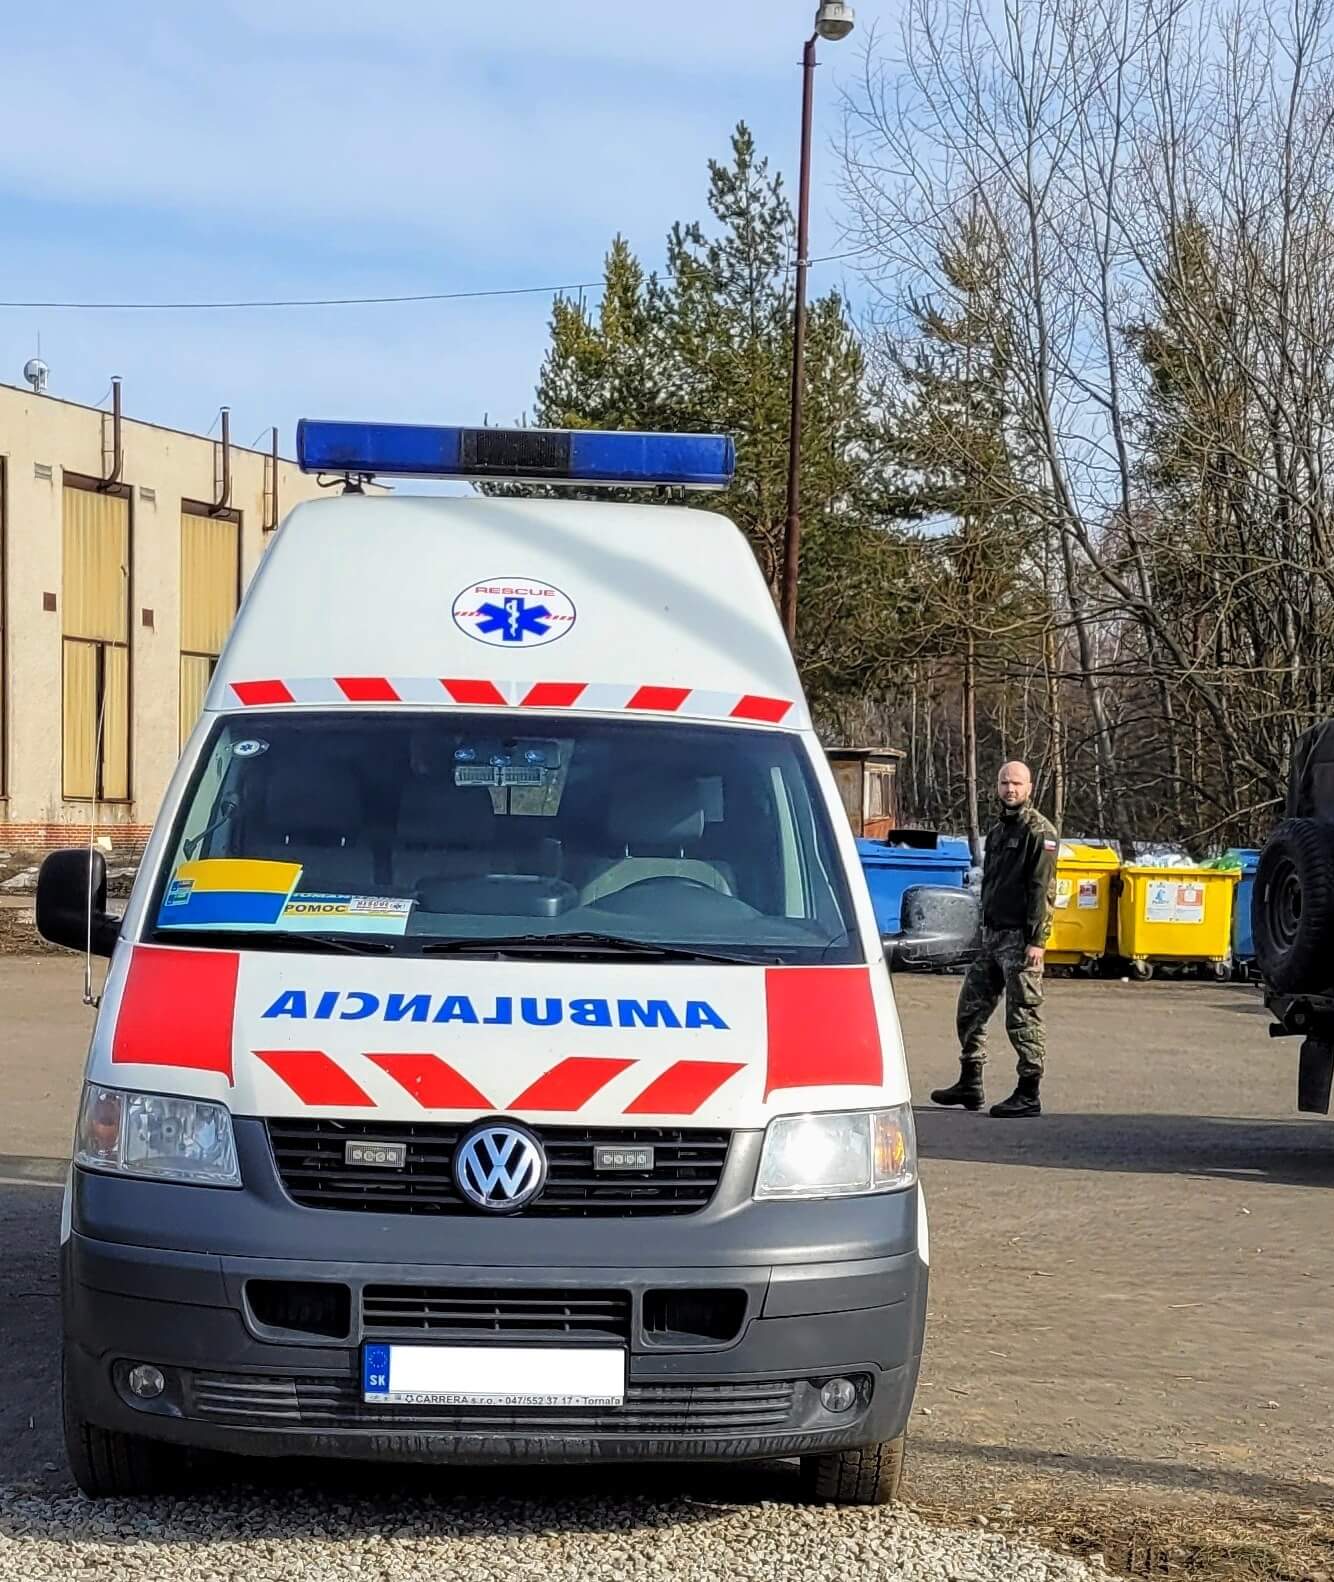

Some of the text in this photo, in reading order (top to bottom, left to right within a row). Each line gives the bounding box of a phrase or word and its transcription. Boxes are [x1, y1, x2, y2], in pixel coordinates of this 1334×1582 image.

[475, 586, 556, 597] RESCUE
[284, 903, 347, 913] POMOC
[369, 1374, 387, 1387] SK
[415, 1394, 469, 1405] CARRERA
[505, 1396, 544, 1406] 047/552
[546, 1396, 559, 1406] 37
[562, 1396, 574, 1406] 17
